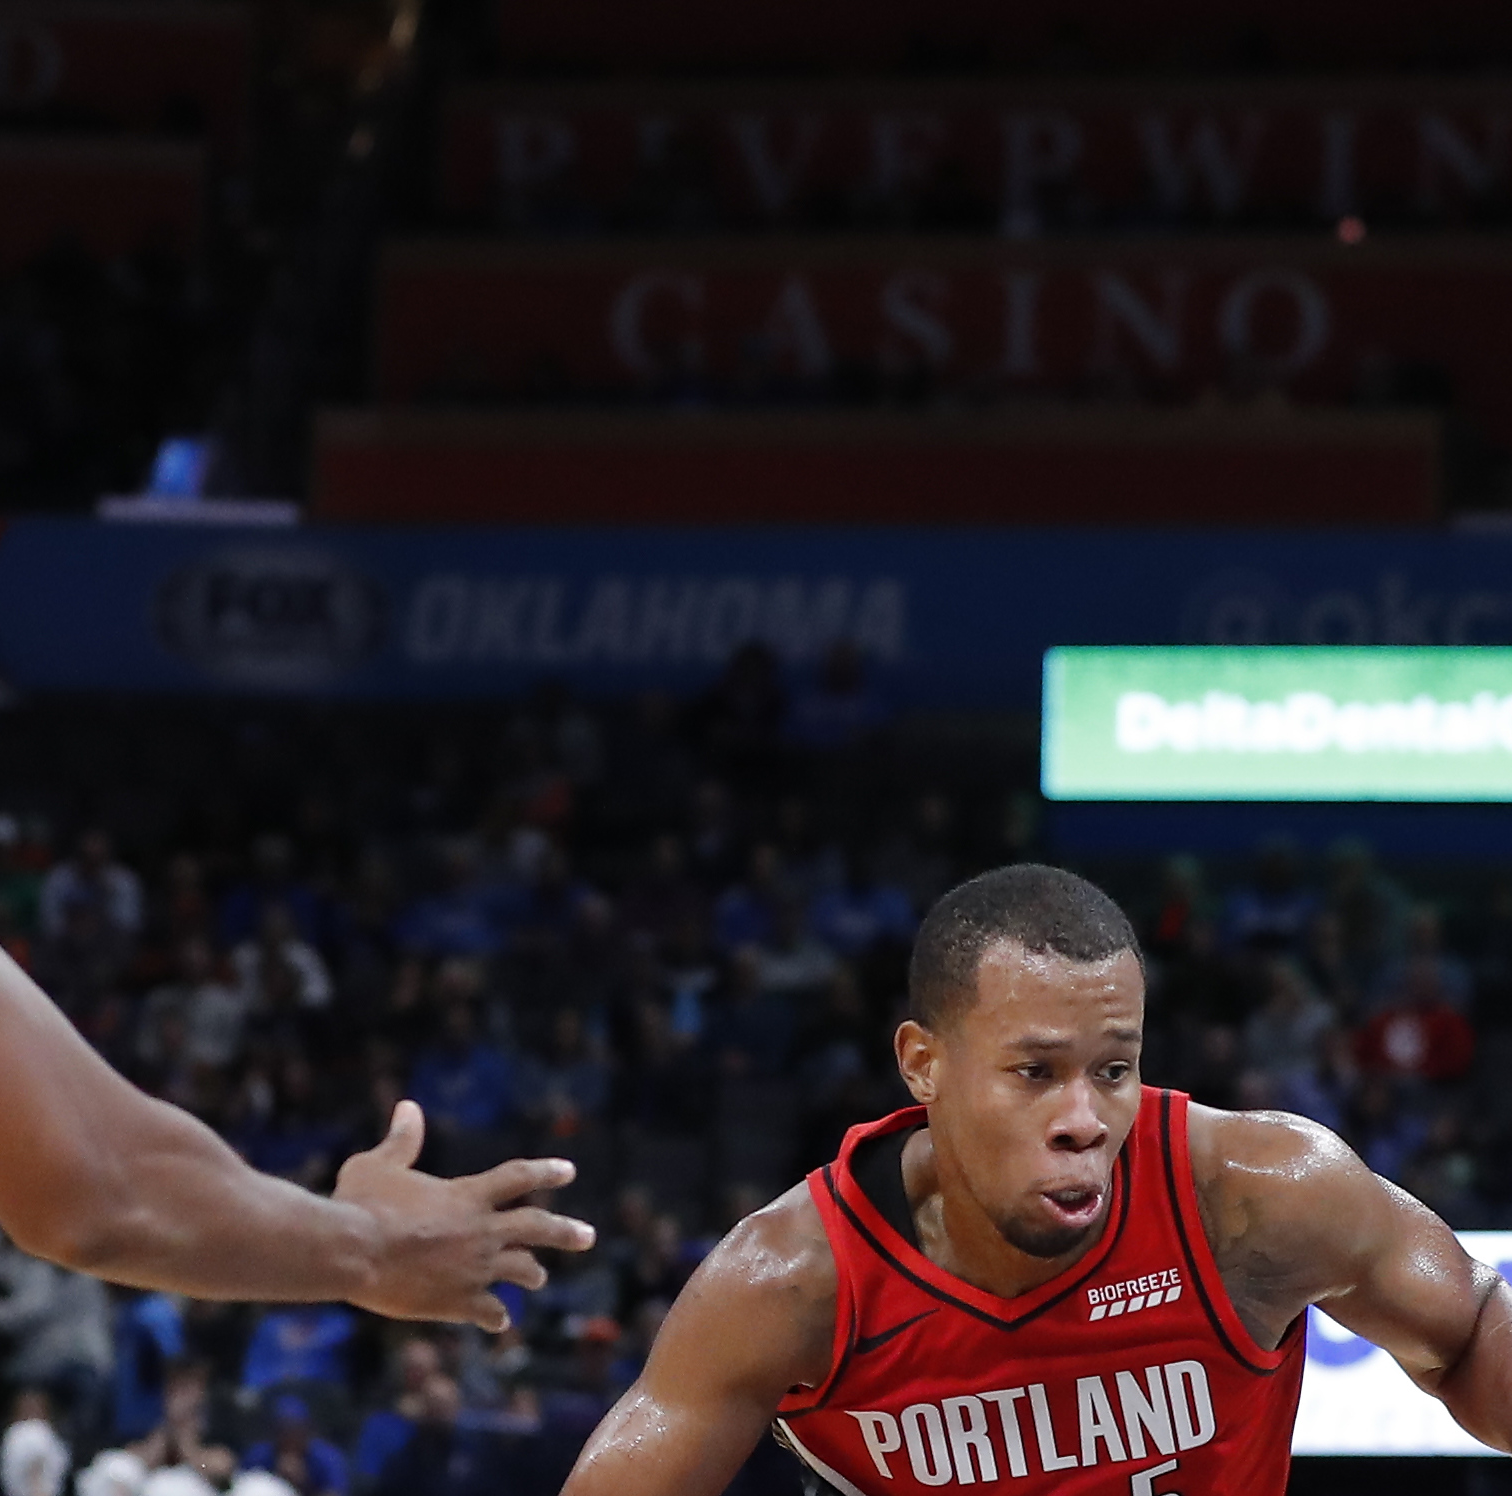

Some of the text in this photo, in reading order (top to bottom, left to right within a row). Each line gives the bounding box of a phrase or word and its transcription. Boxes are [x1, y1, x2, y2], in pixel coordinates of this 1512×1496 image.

[606, 270, 1332, 376] CASINO
[403, 574, 908, 666] OKLAHOMA
[844, 1359, 1217, 1487] PORTLAND
